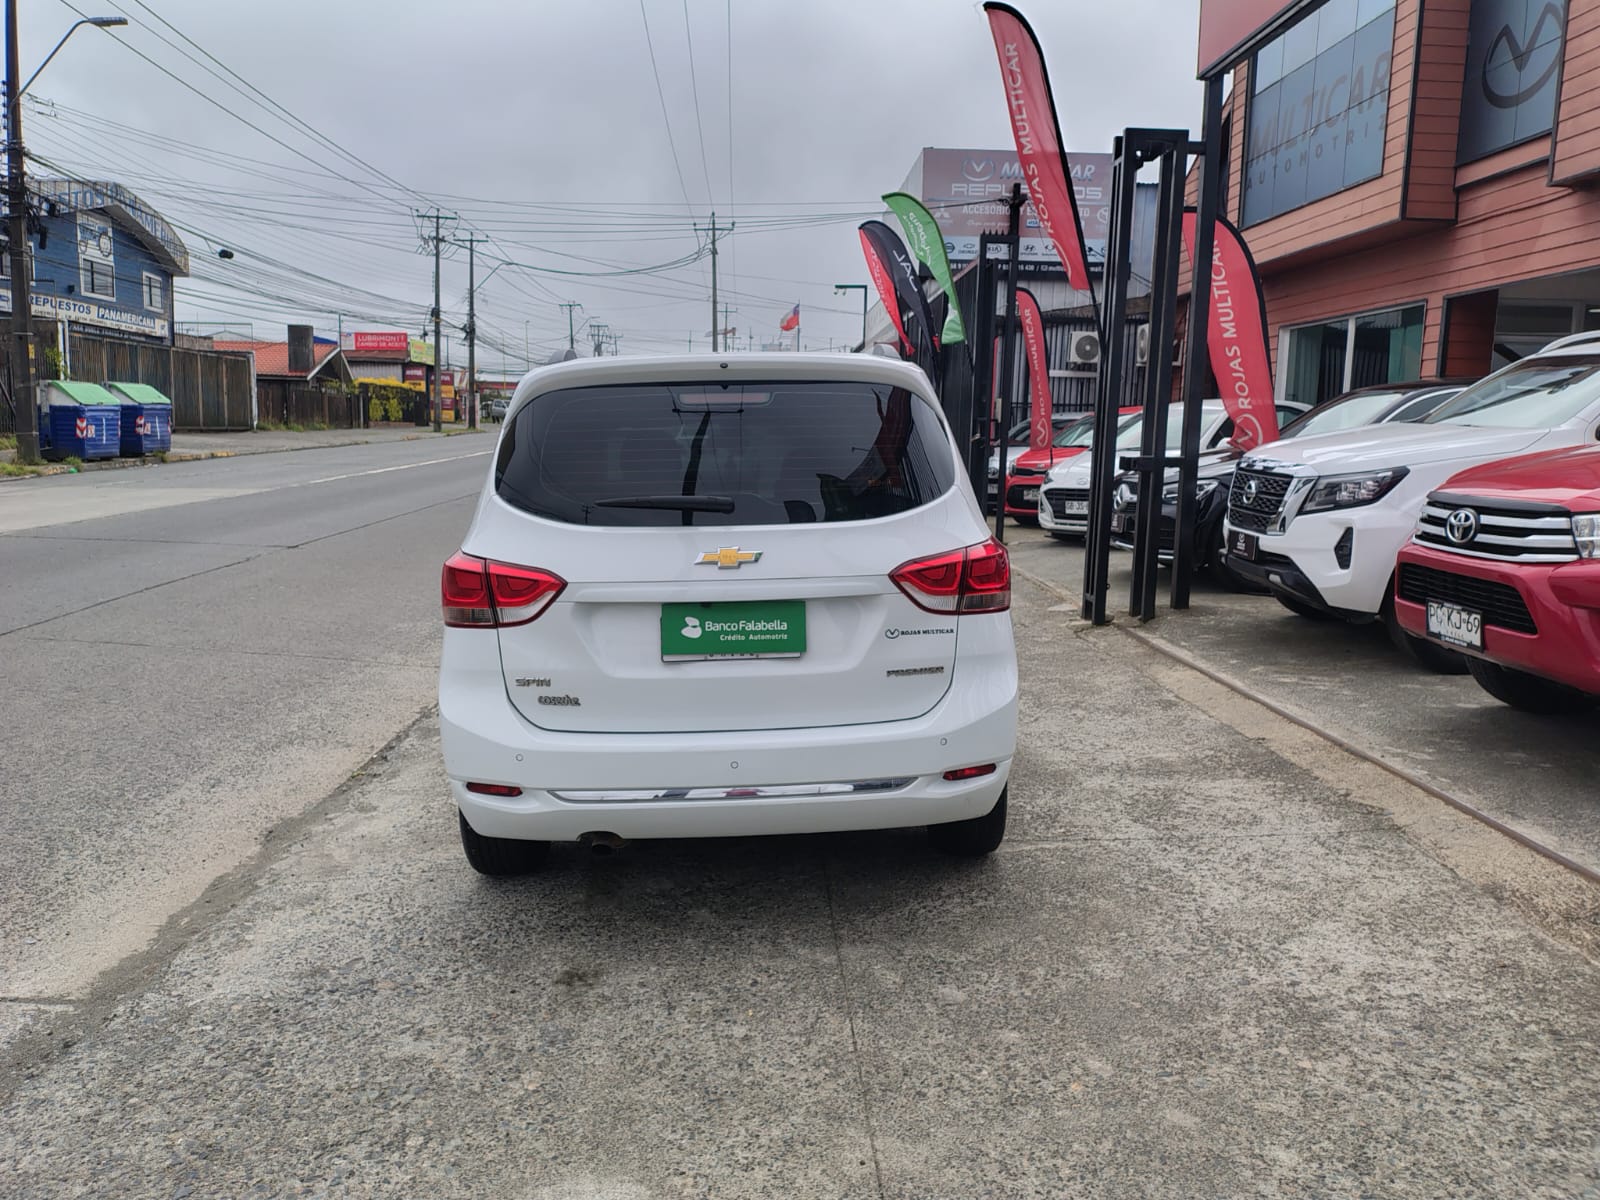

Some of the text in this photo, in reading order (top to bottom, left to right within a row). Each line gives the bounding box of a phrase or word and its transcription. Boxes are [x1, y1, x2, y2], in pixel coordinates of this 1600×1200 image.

[1006, 43, 1033, 155] MULTICAR
[1248, 51, 1389, 168] MULTICAR
[962, 204, 1012, 215] ACCESORIO
[892, 250, 918, 292] JAC
[29, 295, 91, 315] REPUESTOS
[98, 307, 155, 328] PANAMERICANA
[1024, 308, 1039, 371] MULTICAR
[1226, 345, 1252, 409] ROJAS
[705, 620, 788, 631] Banco Falabella
[749, 633, 788, 641] Automotriz
[515, 678, 551, 687] SPIN
